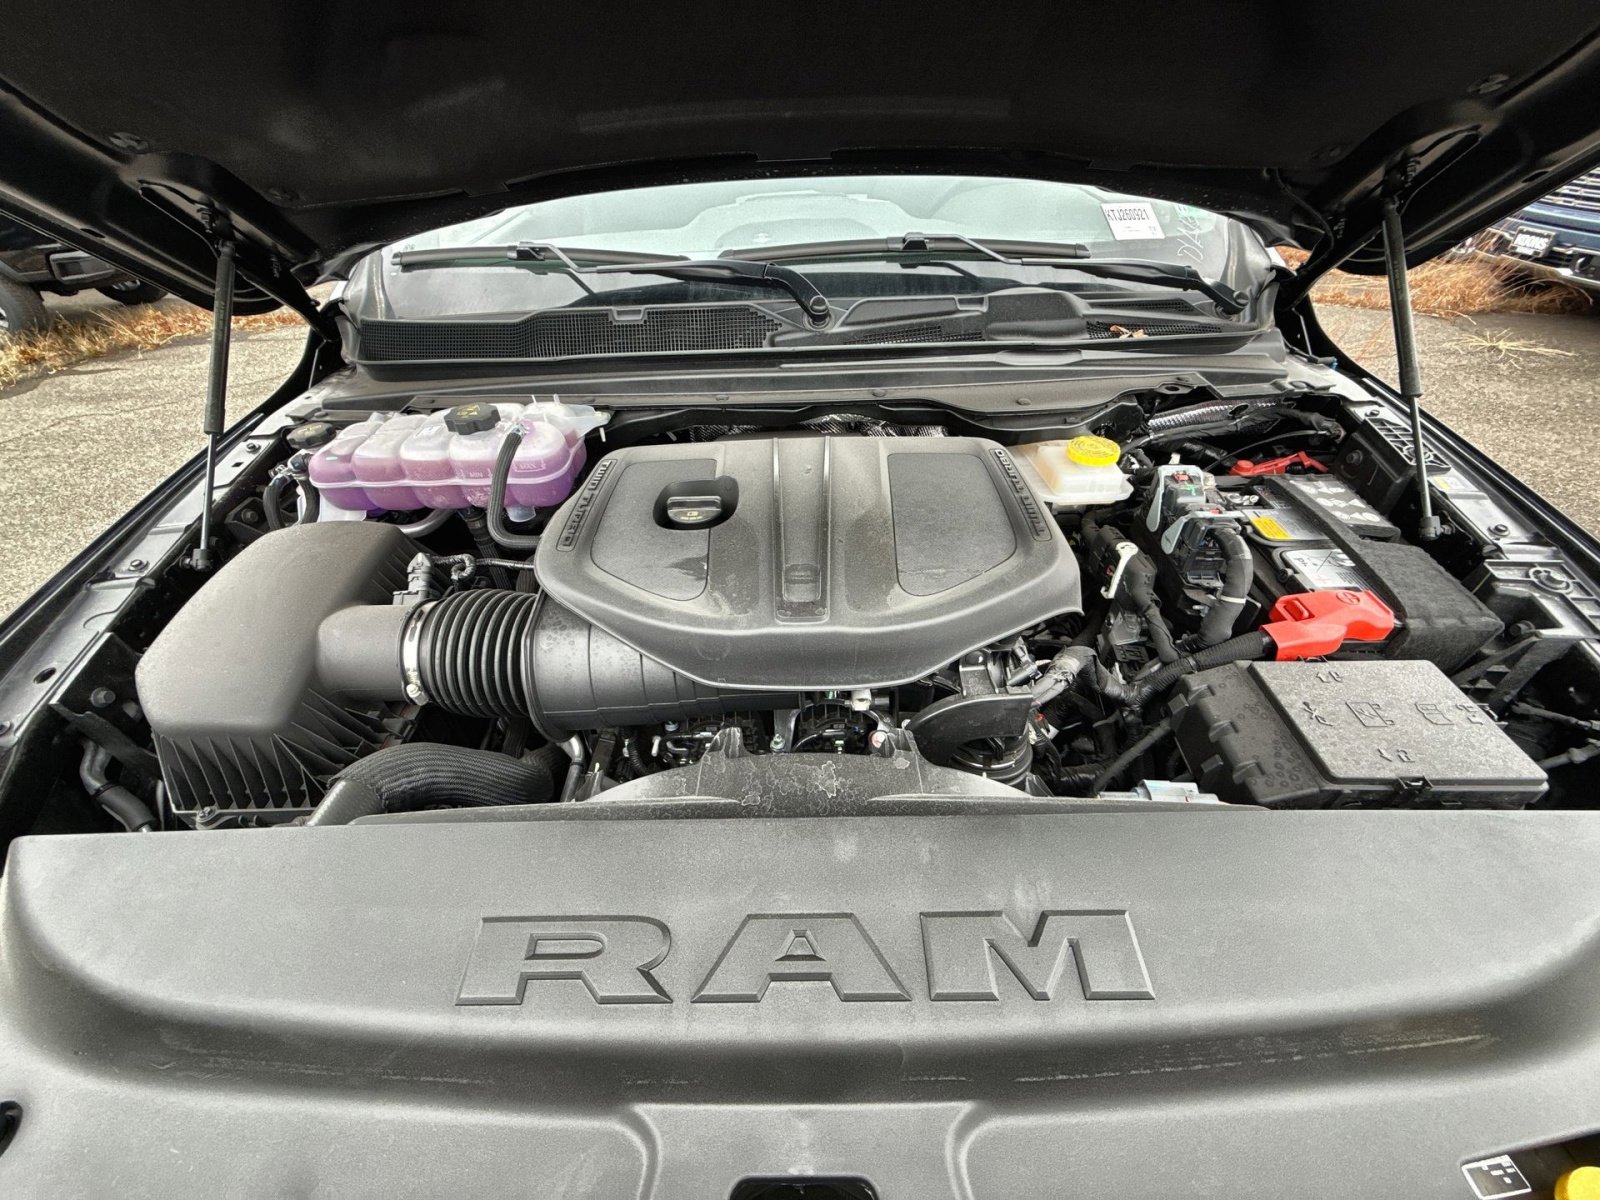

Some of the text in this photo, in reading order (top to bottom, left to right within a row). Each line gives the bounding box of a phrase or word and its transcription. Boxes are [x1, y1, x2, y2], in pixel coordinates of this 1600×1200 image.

[562, 459, 613, 548] TWIN TURBO
[993, 449, 1046, 537] TWIN TURBO
[455, 910, 1156, 1006] RAM
